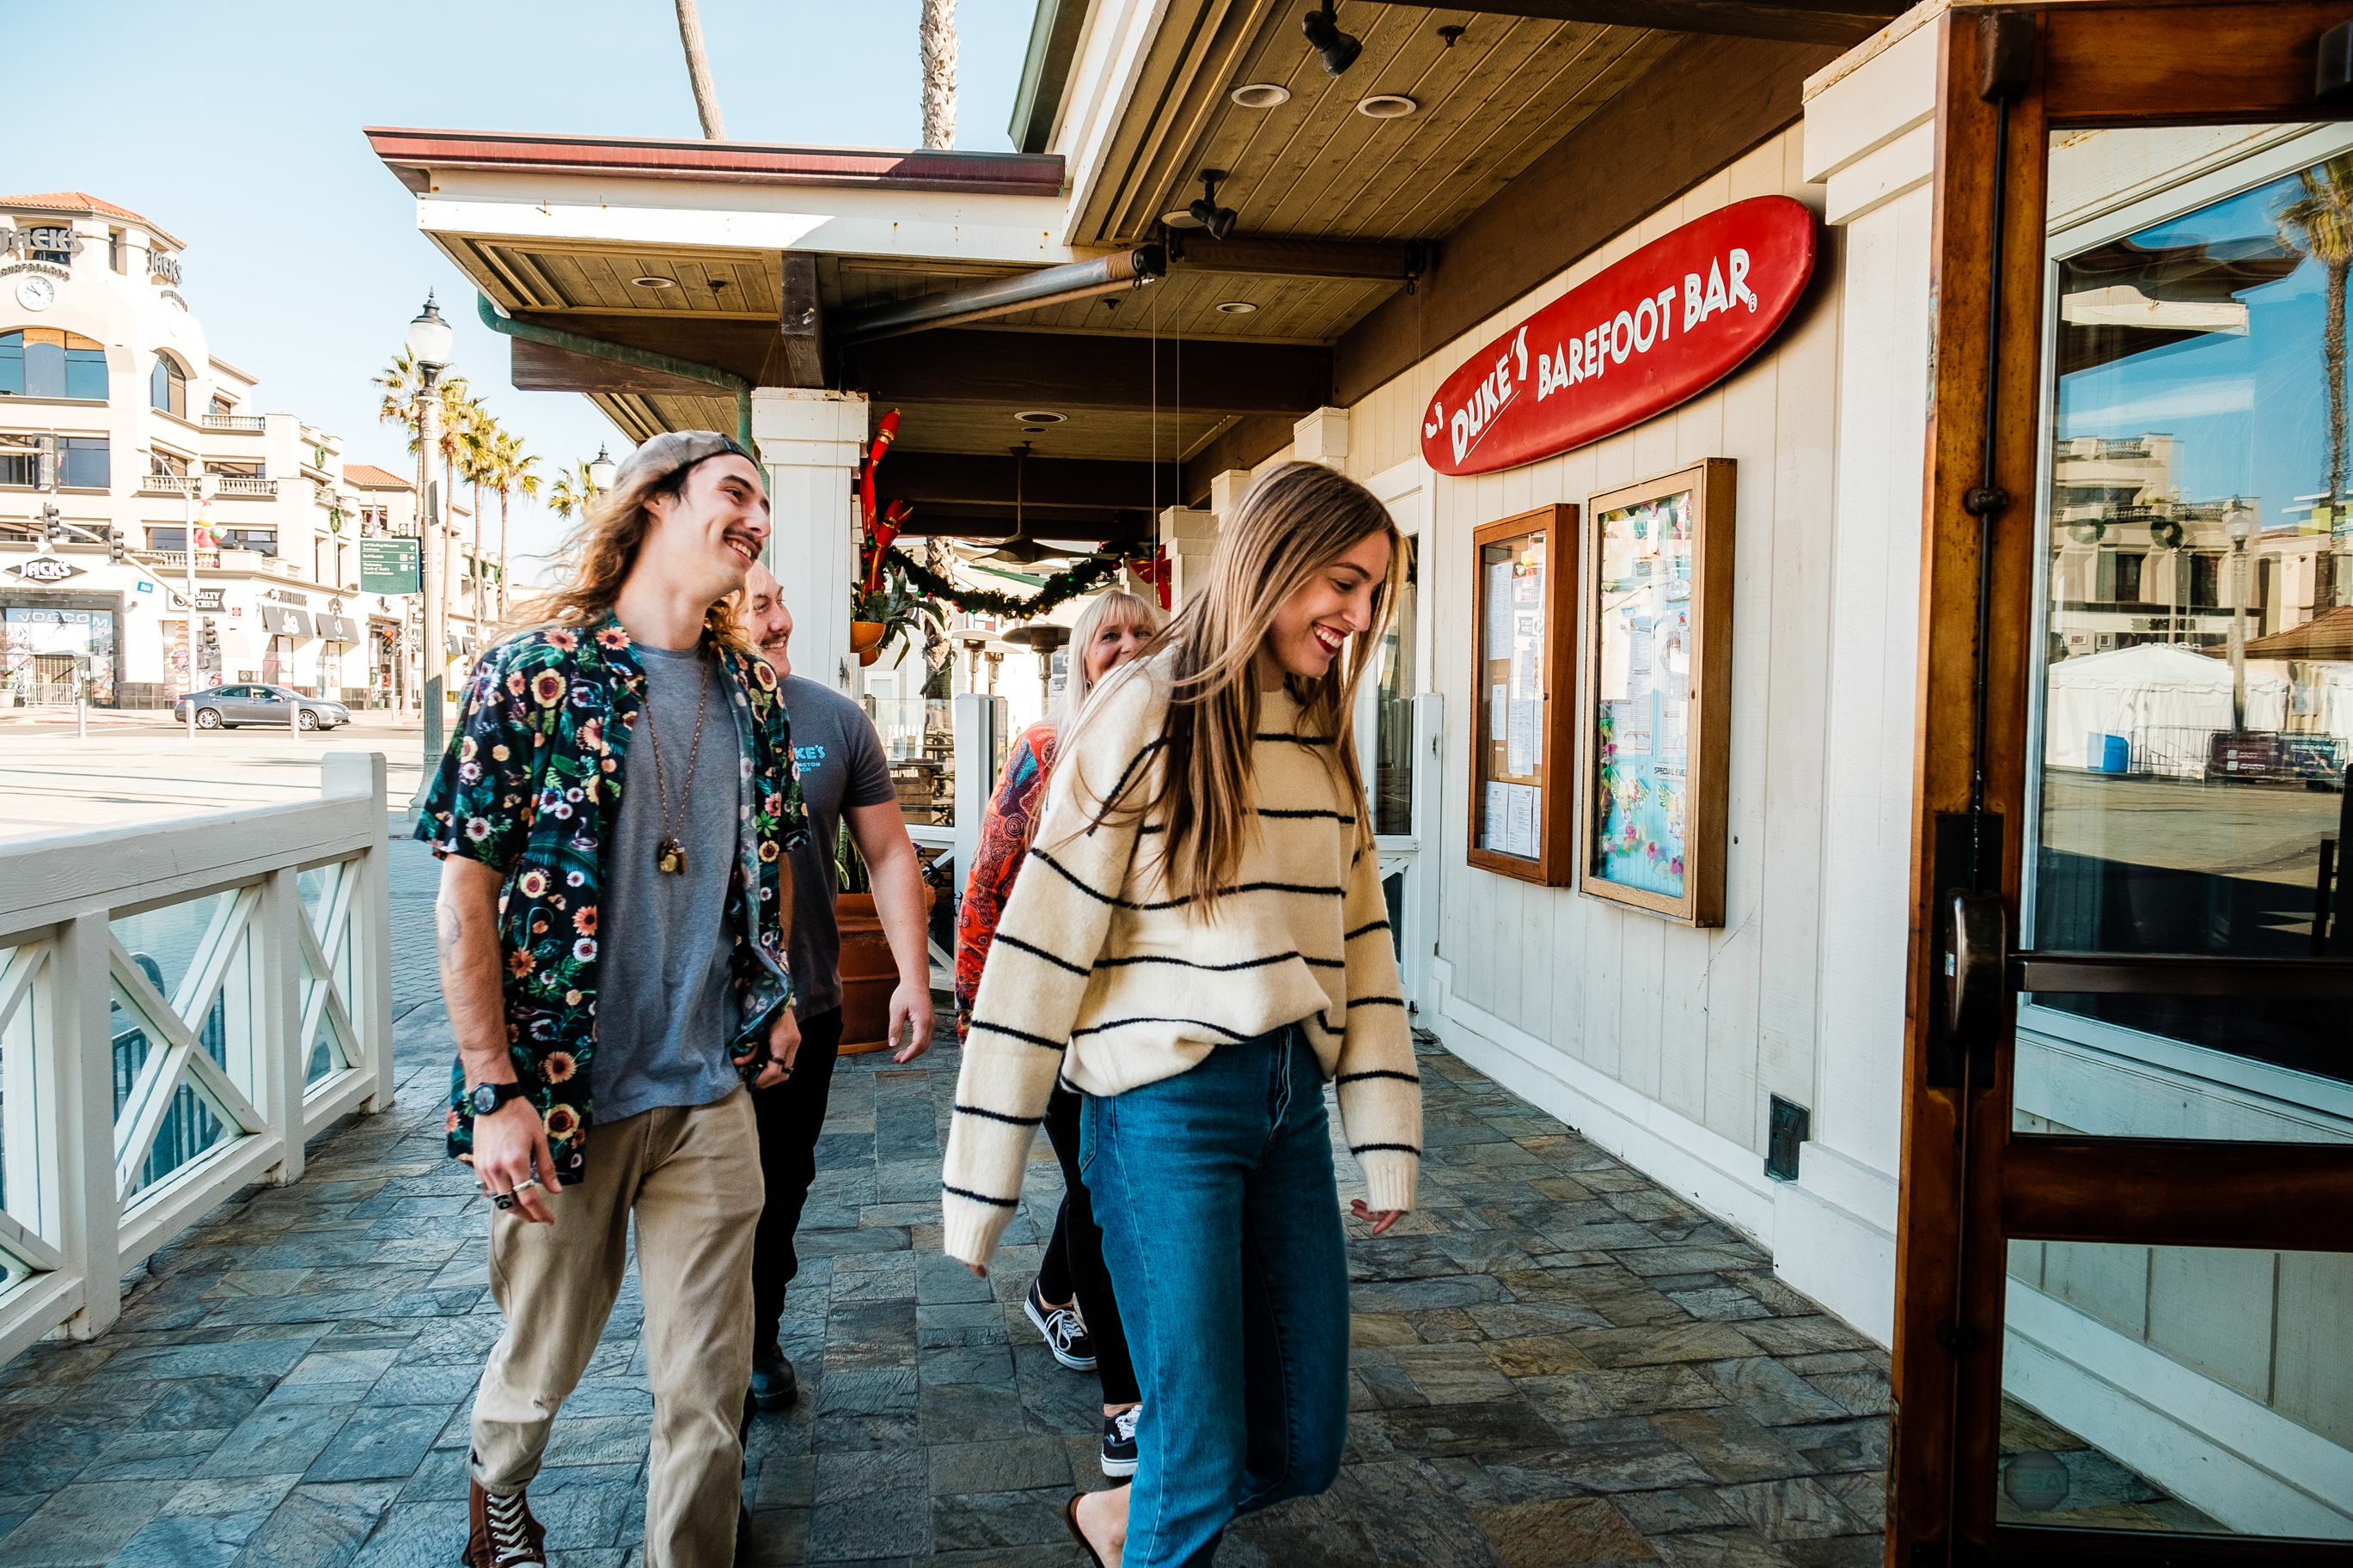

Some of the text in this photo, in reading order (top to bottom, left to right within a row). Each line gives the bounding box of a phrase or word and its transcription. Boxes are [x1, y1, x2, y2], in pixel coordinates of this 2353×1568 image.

[1451, 326, 1528, 466] DUKE'S
[1537, 285, 1677, 402] BAREFOOT
[195, 600, 220, 608] CREW
[793, 744, 825, 760] KE'S
[1653, 766, 1686, 777] SPECIAL EVE
